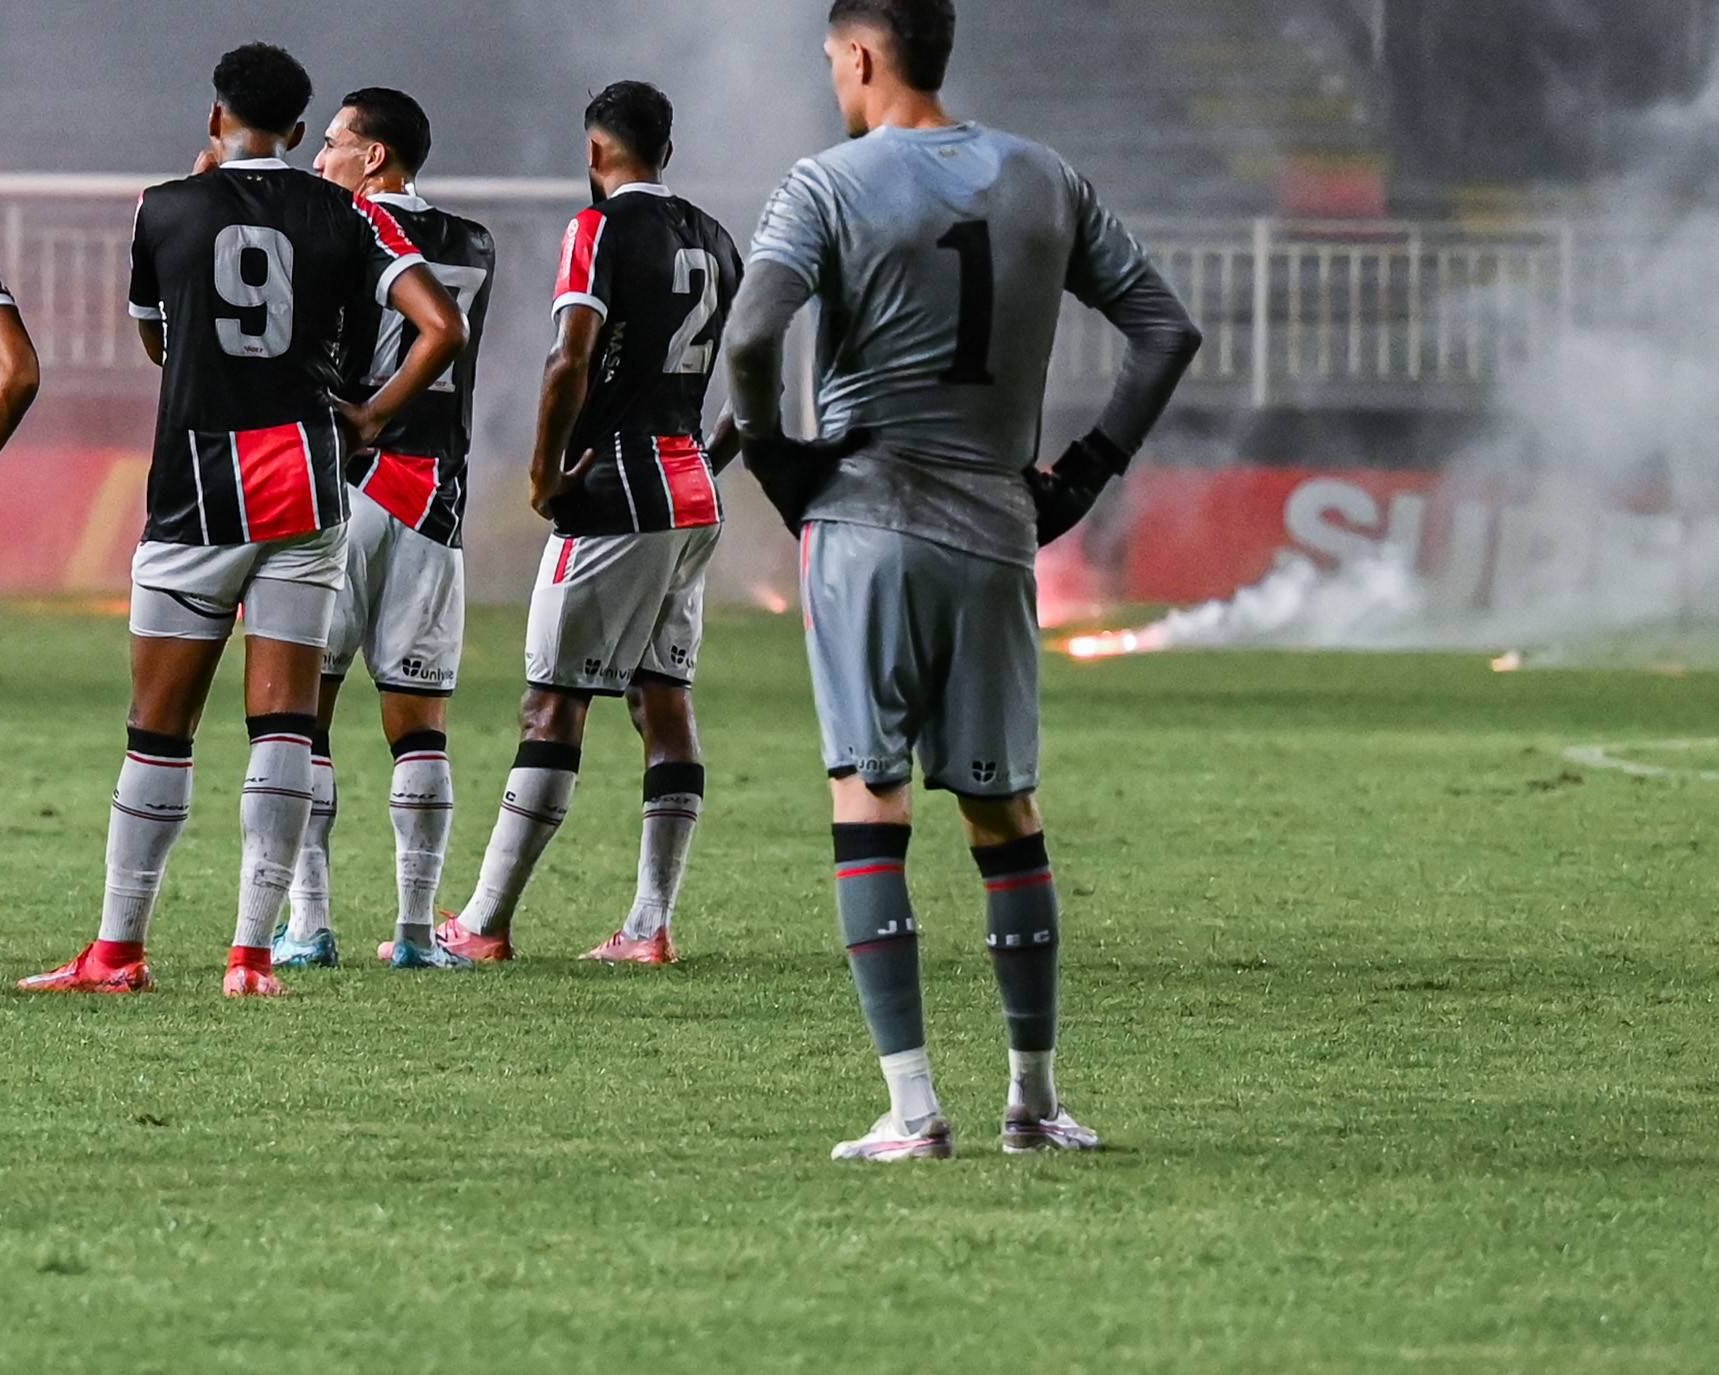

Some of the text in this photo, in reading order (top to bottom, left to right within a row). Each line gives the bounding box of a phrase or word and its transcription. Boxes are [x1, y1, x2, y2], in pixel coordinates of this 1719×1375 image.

[214, 224, 293, 359] 9
[662, 247, 720, 374] 2
[936, 219, 994, 385] 1
